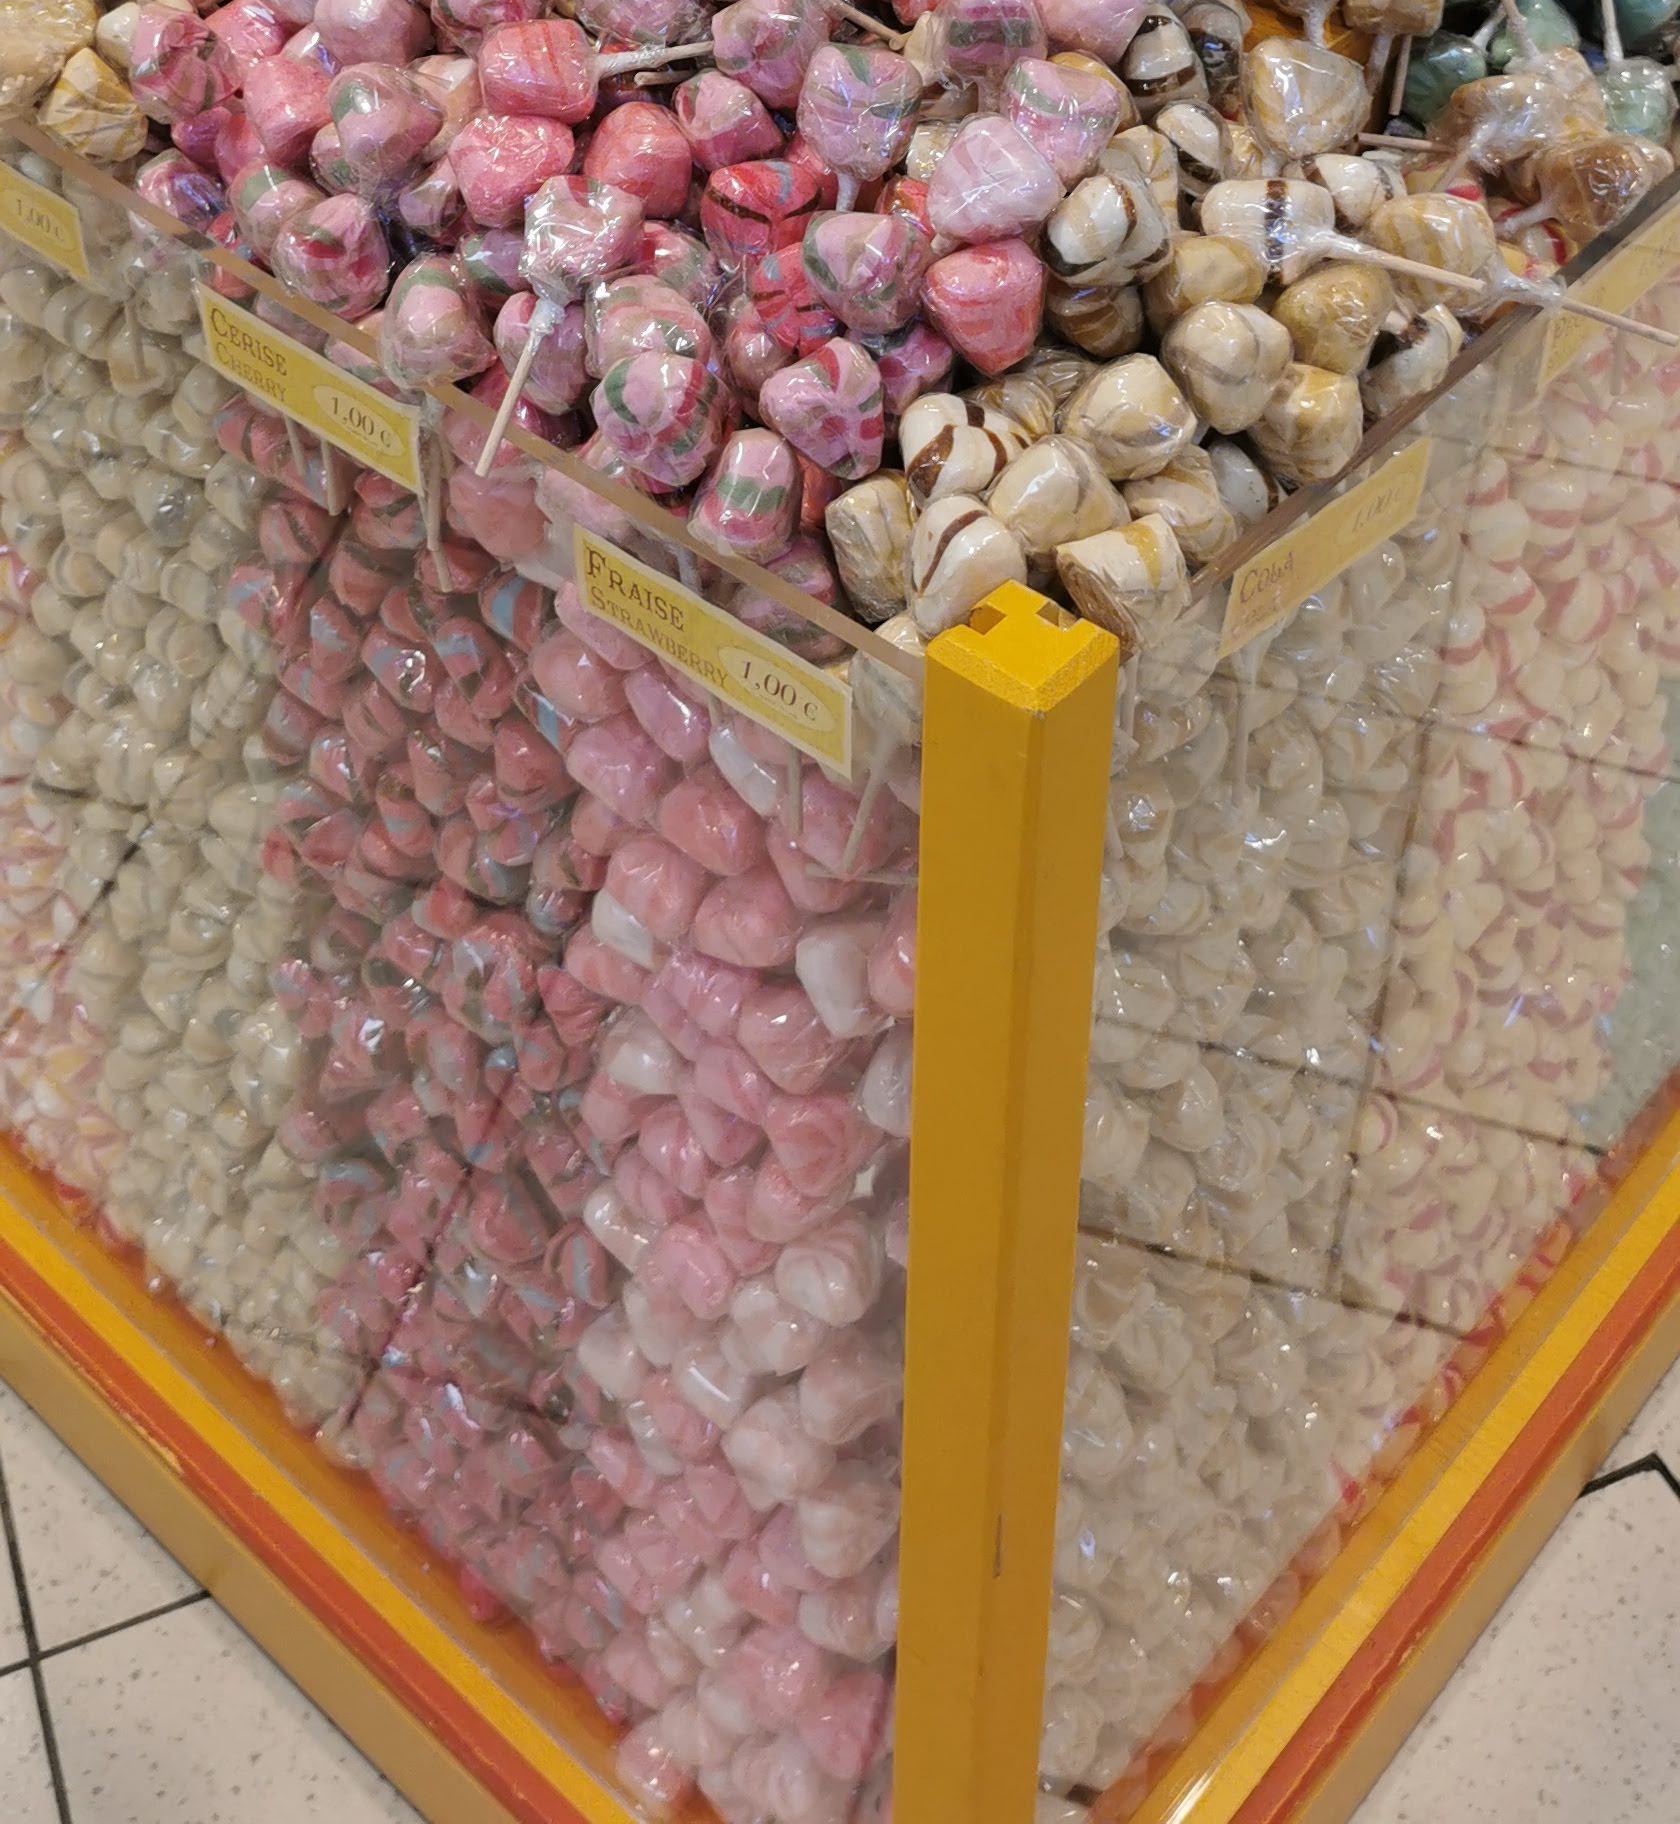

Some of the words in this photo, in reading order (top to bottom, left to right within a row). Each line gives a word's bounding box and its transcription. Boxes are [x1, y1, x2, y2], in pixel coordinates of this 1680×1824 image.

[211, 307, 287, 376] CERISE
[216, 341, 287, 403] CHERRY
[330, 396, 375, 437] 1,00
[586, 546, 686, 632] FRAISE
[591, 586, 729, 689] STRAWBERRY
[742, 660, 798, 707] 1,00
[803, 701, 819, 723] €
